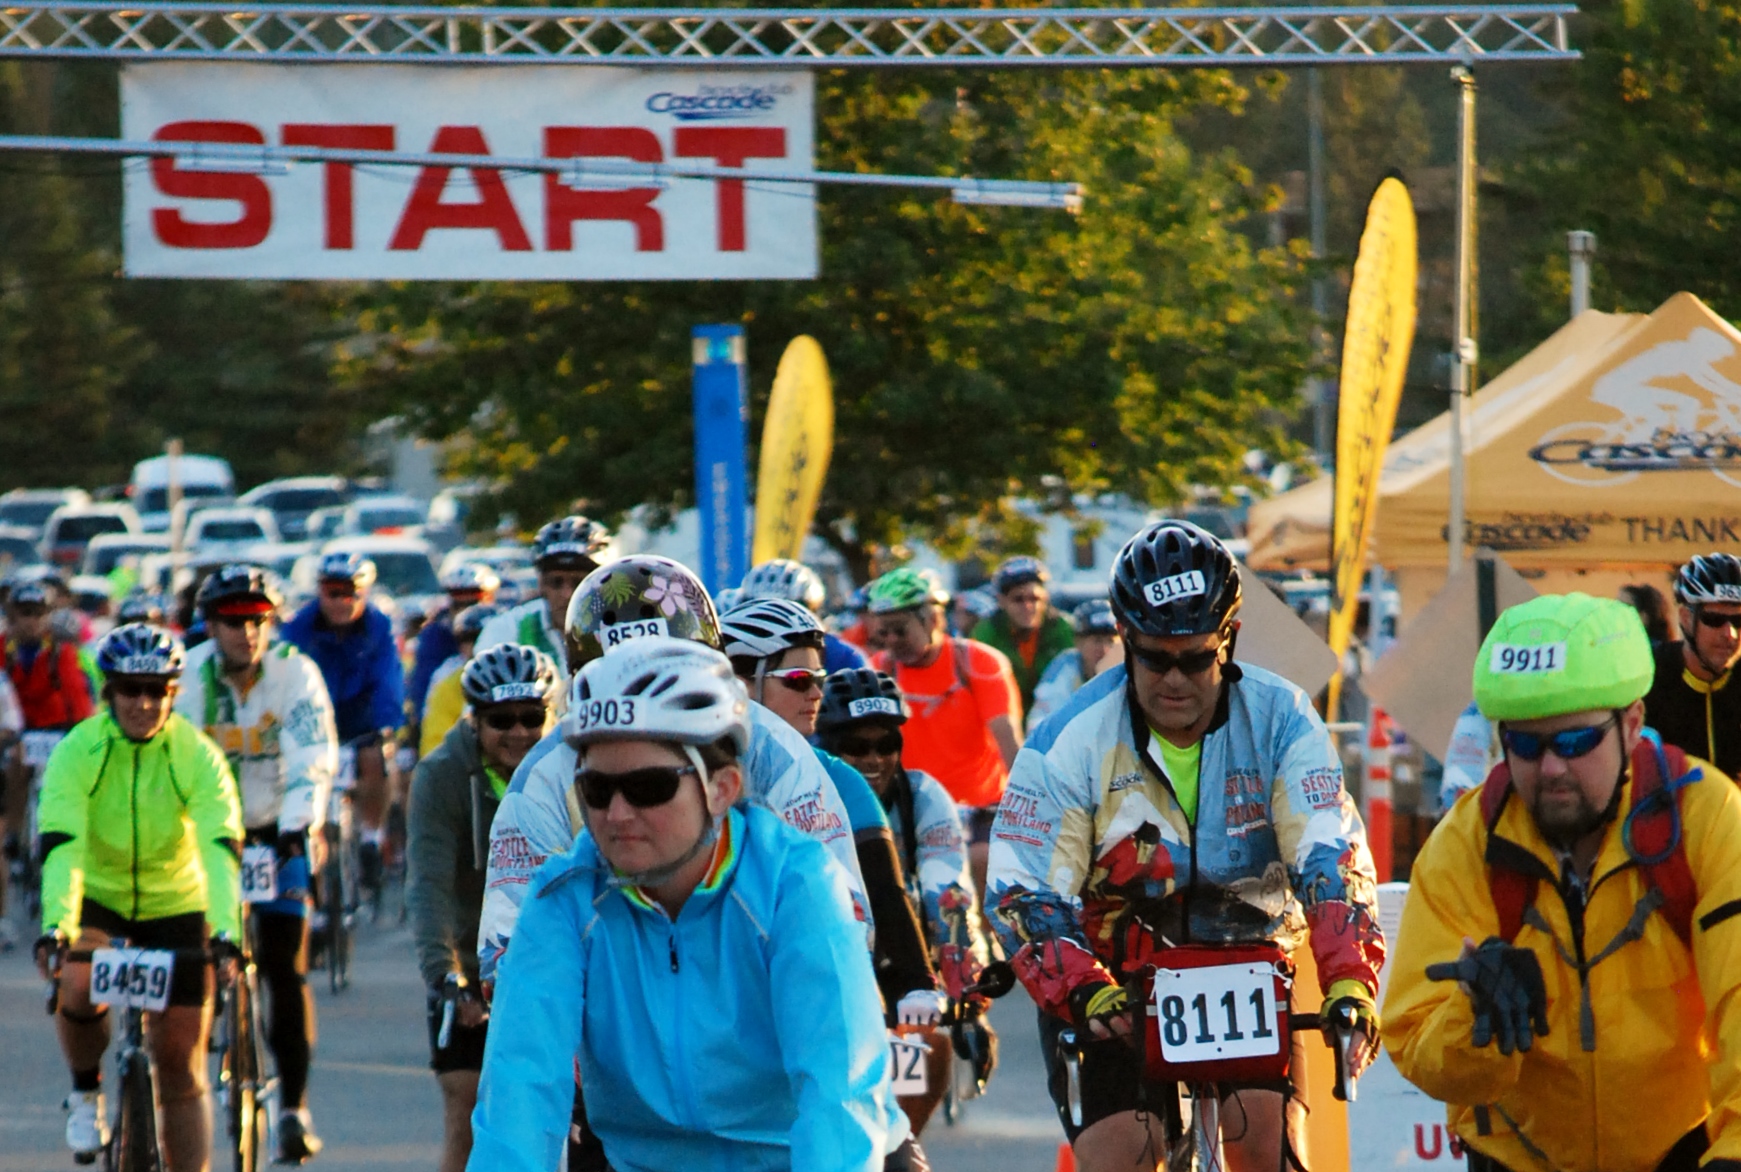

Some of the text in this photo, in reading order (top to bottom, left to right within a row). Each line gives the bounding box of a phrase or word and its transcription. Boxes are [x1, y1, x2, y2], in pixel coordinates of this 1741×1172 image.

[646, 89, 776, 114] Cascade
[152, 120, 786, 251] START
[1152, 573, 1199, 601] 8111
[1501, 647, 1556, 671] 9911
[580, 700, 635, 729] 9903
[94, 961, 168, 999] 8459
[1162, 987, 1273, 1047] 8111
